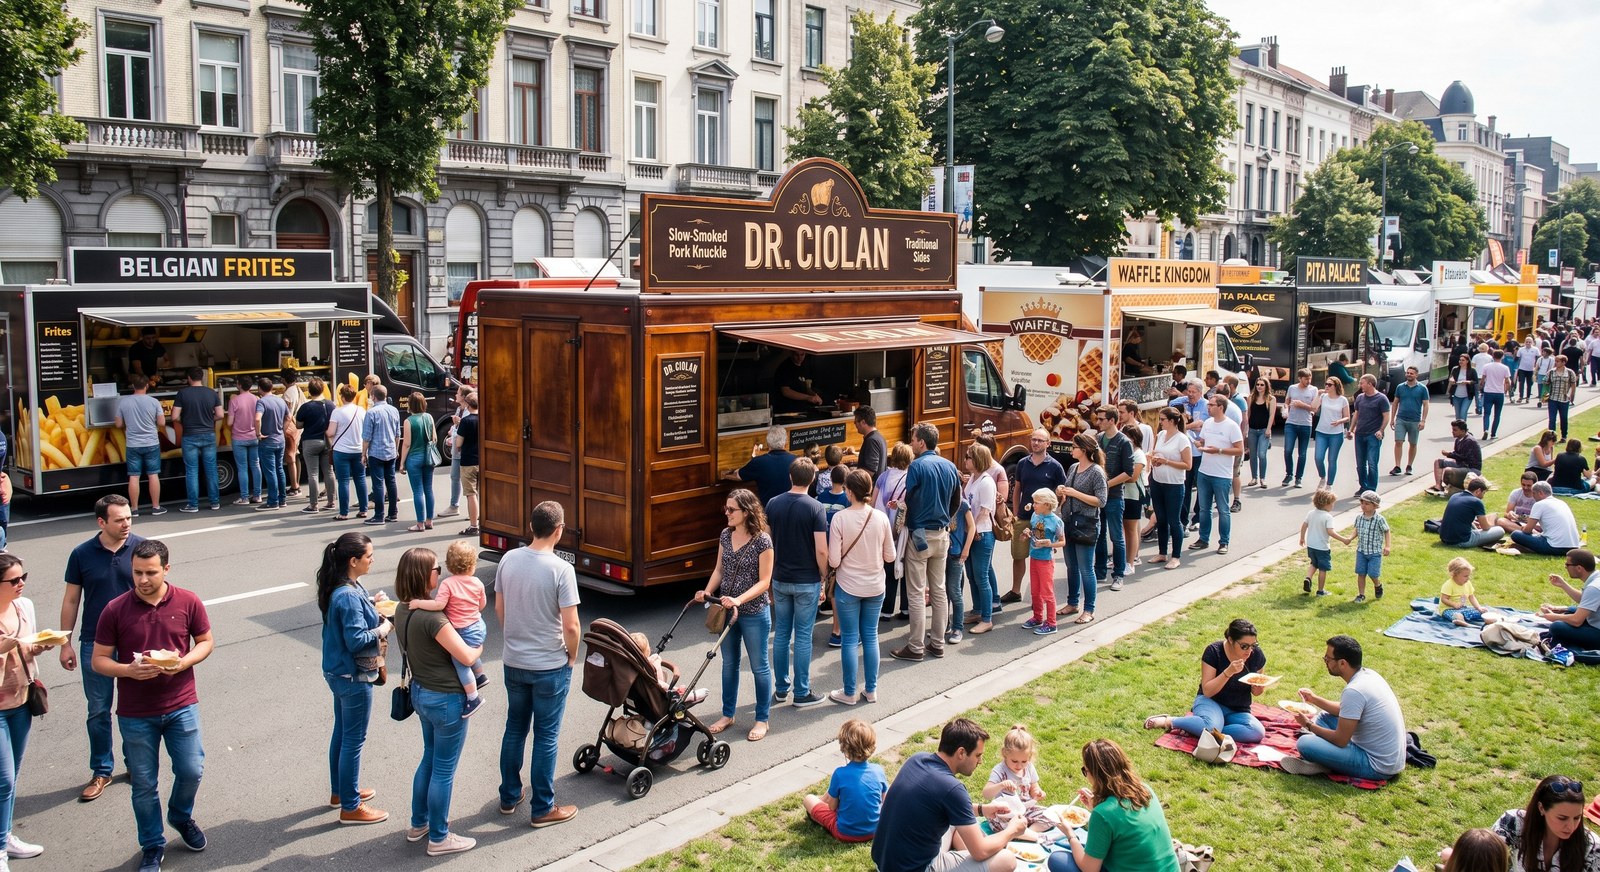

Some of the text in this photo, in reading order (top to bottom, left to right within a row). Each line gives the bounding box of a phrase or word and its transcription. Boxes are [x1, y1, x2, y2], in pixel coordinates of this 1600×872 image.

[669, 227, 728, 243] Slow-Smoked
[669, 243, 727, 258] Pork Knuckle
[744, 222, 890, 271] DR. CIOLAN
[913, 250, 930, 263] Sides
[119, 257, 297, 278] BELGIAN FRITES
[1118, 264, 1162, 283] WAFFLE
[1165, 266, 1211, 283] KINGDOM
[1306, 262, 1361, 283] PITA PALACE
[1237, 293, 1276, 301] PALACE
[44, 326, 73, 337] Frites
[663, 361, 698, 376] DR. CIOLAN
